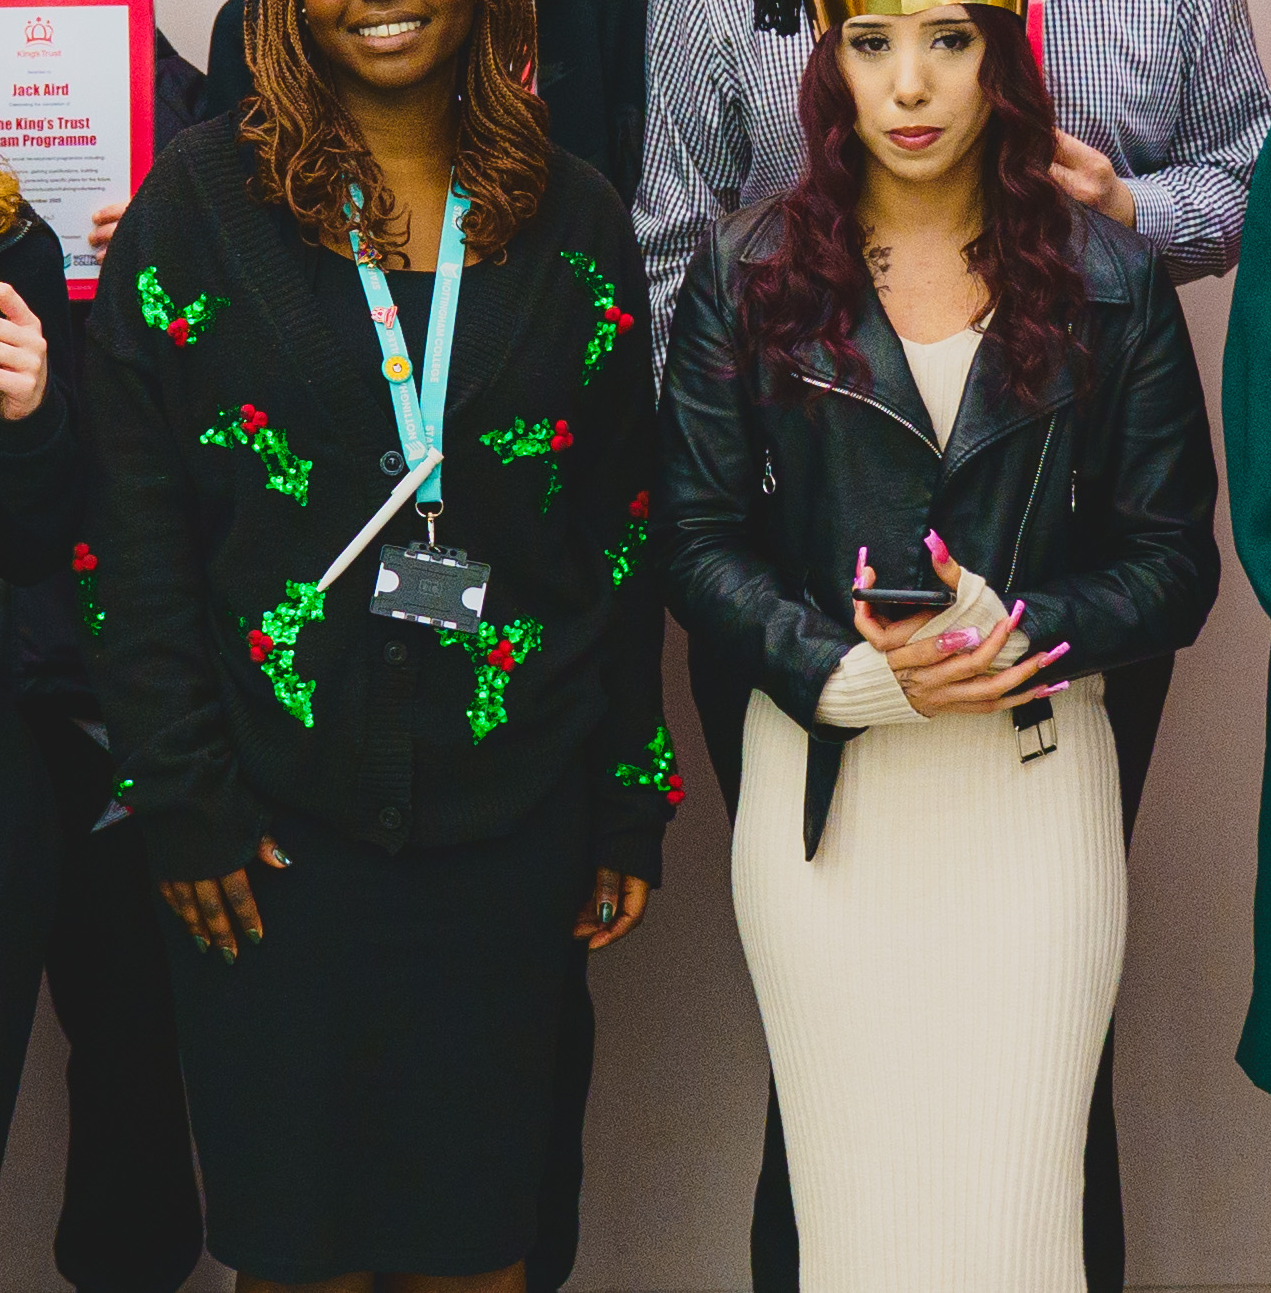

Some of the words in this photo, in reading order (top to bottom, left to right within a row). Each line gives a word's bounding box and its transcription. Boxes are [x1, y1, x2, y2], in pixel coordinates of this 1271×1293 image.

[12, 83, 40, 97] Jack
[43, 83, 69, 96] Aird
[15, 117, 54, 132] King's
[57, 117, 90, 129] Trust
[23, 134, 97, 148] Programme
[369, 267, 382, 291] STAF
[435, 277, 453, 338] NOTTINGHAM
[429, 338, 445, 384] COLLEGE
[398, 381, 418, 441] NOTTINGH
